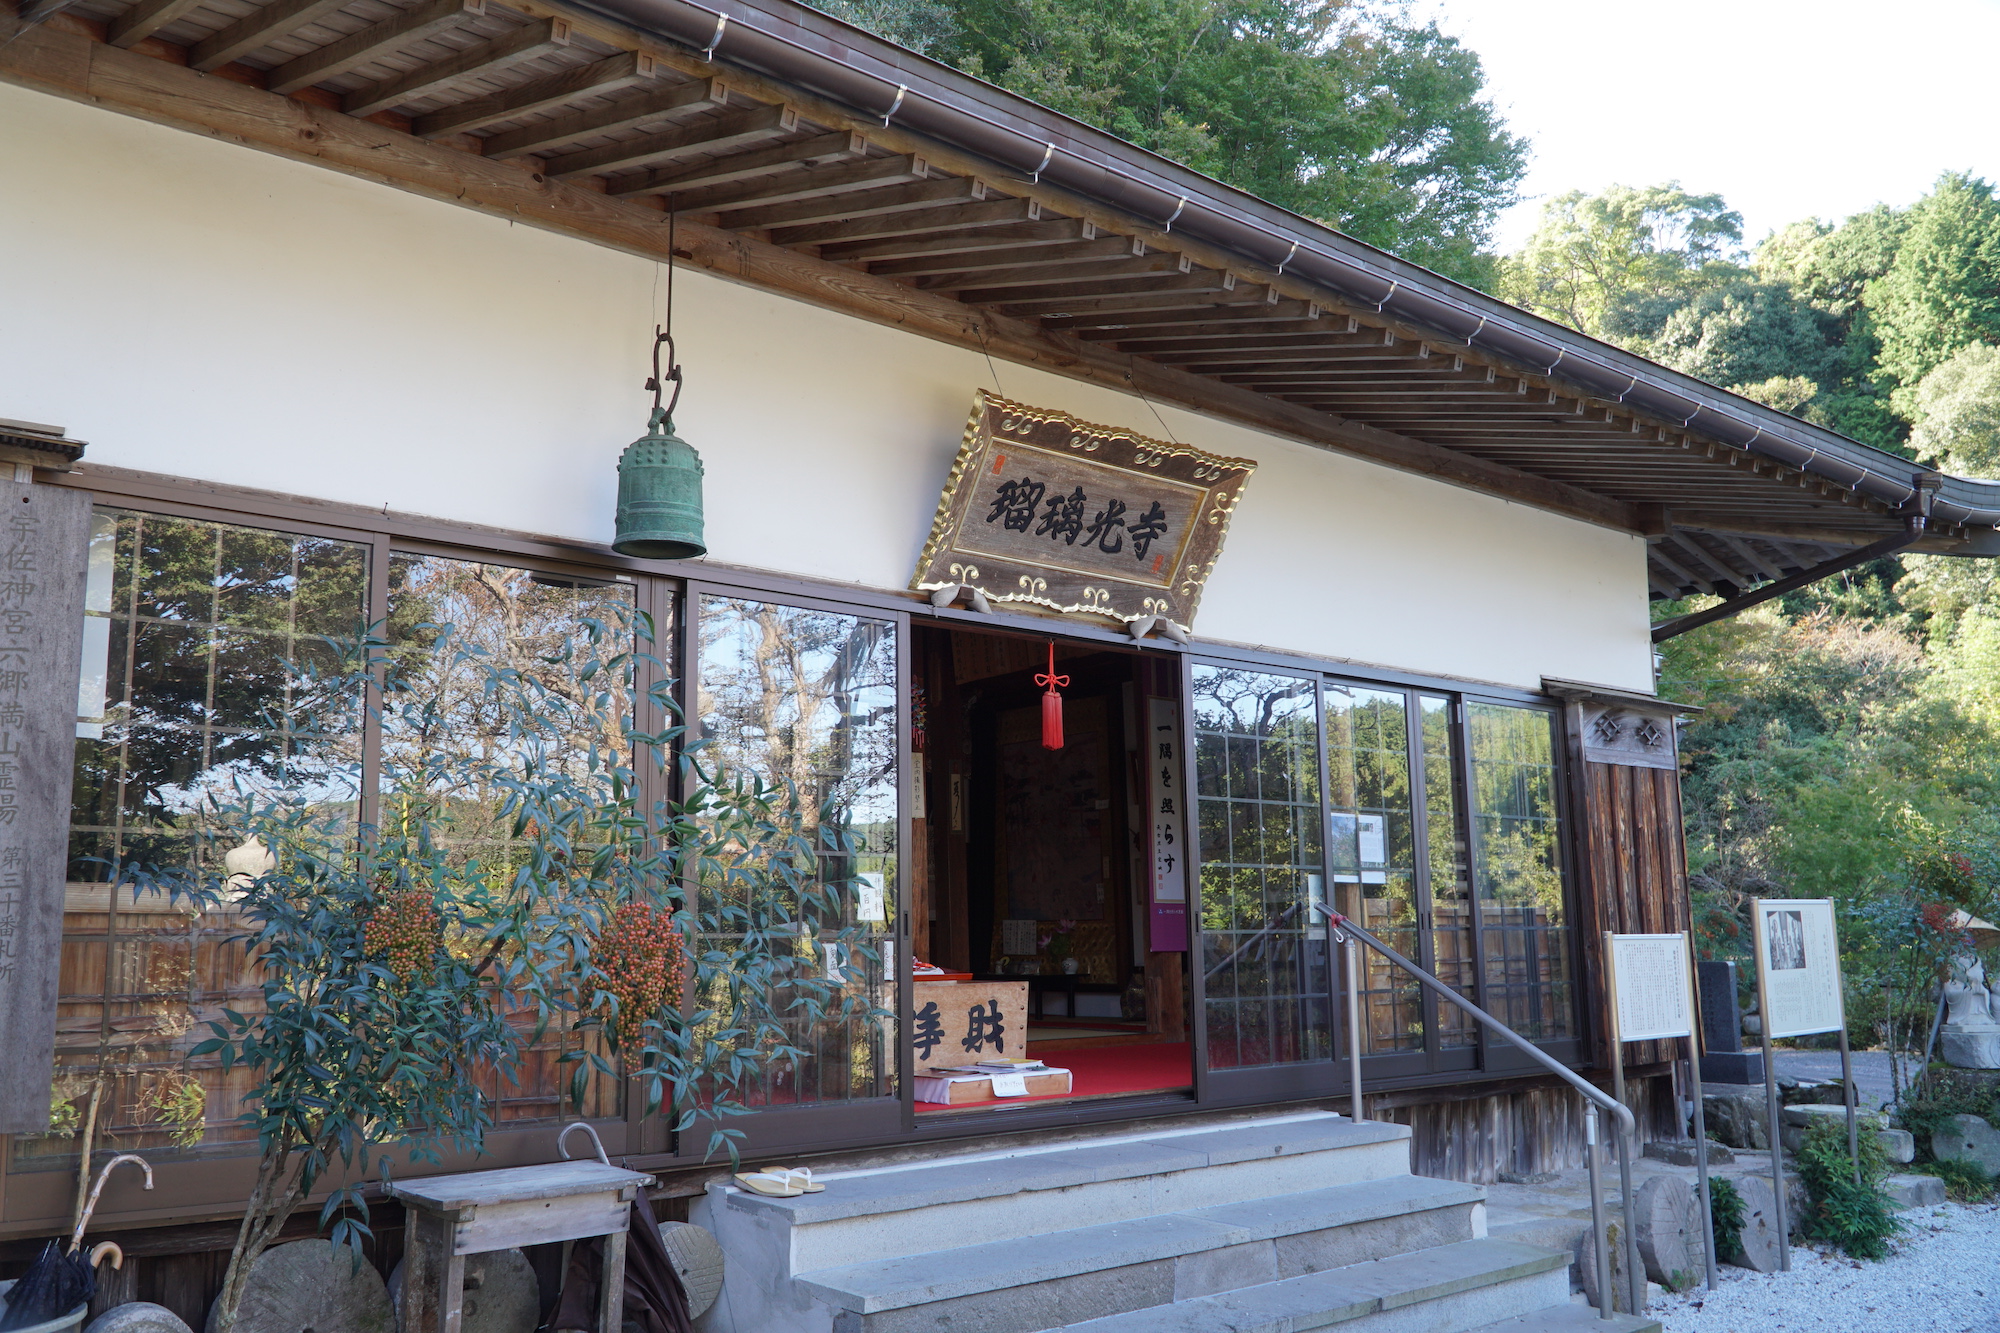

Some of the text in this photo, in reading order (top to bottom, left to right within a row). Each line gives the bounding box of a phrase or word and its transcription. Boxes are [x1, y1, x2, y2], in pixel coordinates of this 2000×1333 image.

[986, 477, 1168, 562] 瑠璃光寺
[1156, 724, 1176, 874] 一隅を照らす
